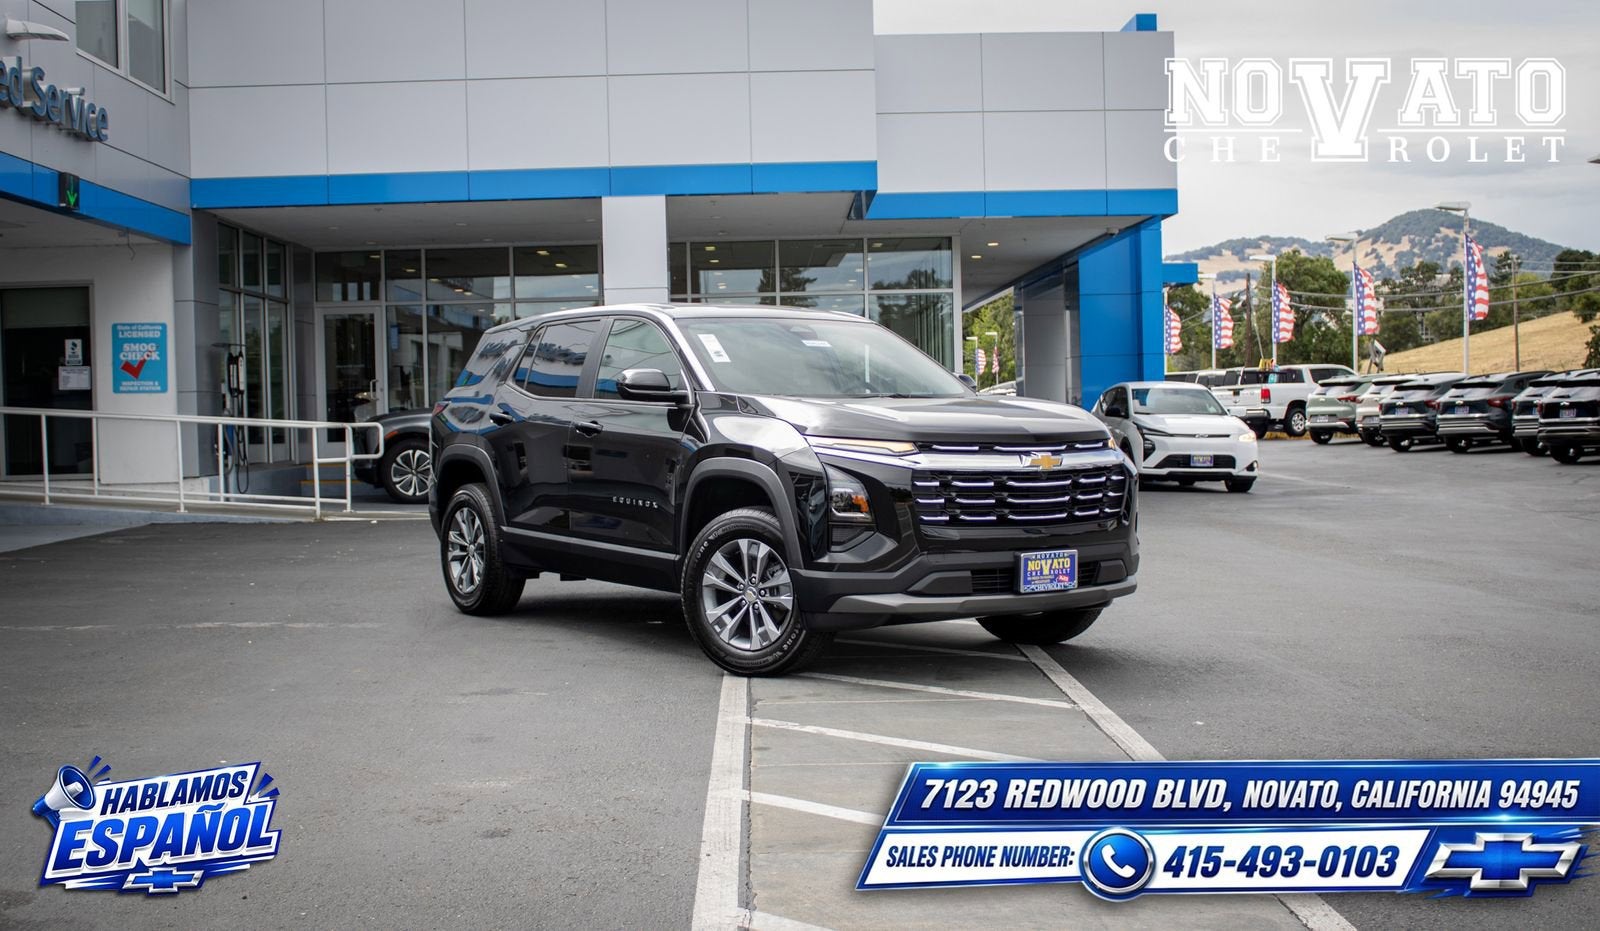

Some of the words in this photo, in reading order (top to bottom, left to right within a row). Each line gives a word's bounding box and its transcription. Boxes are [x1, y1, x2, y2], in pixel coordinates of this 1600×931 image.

[31, 66, 109, 142] Service
[123, 343, 156, 351] SMOG
[120, 352, 160, 360] CHECK
[612, 496, 659, 509] EQUINOX
[1027, 558, 1071, 575] NOVATO
